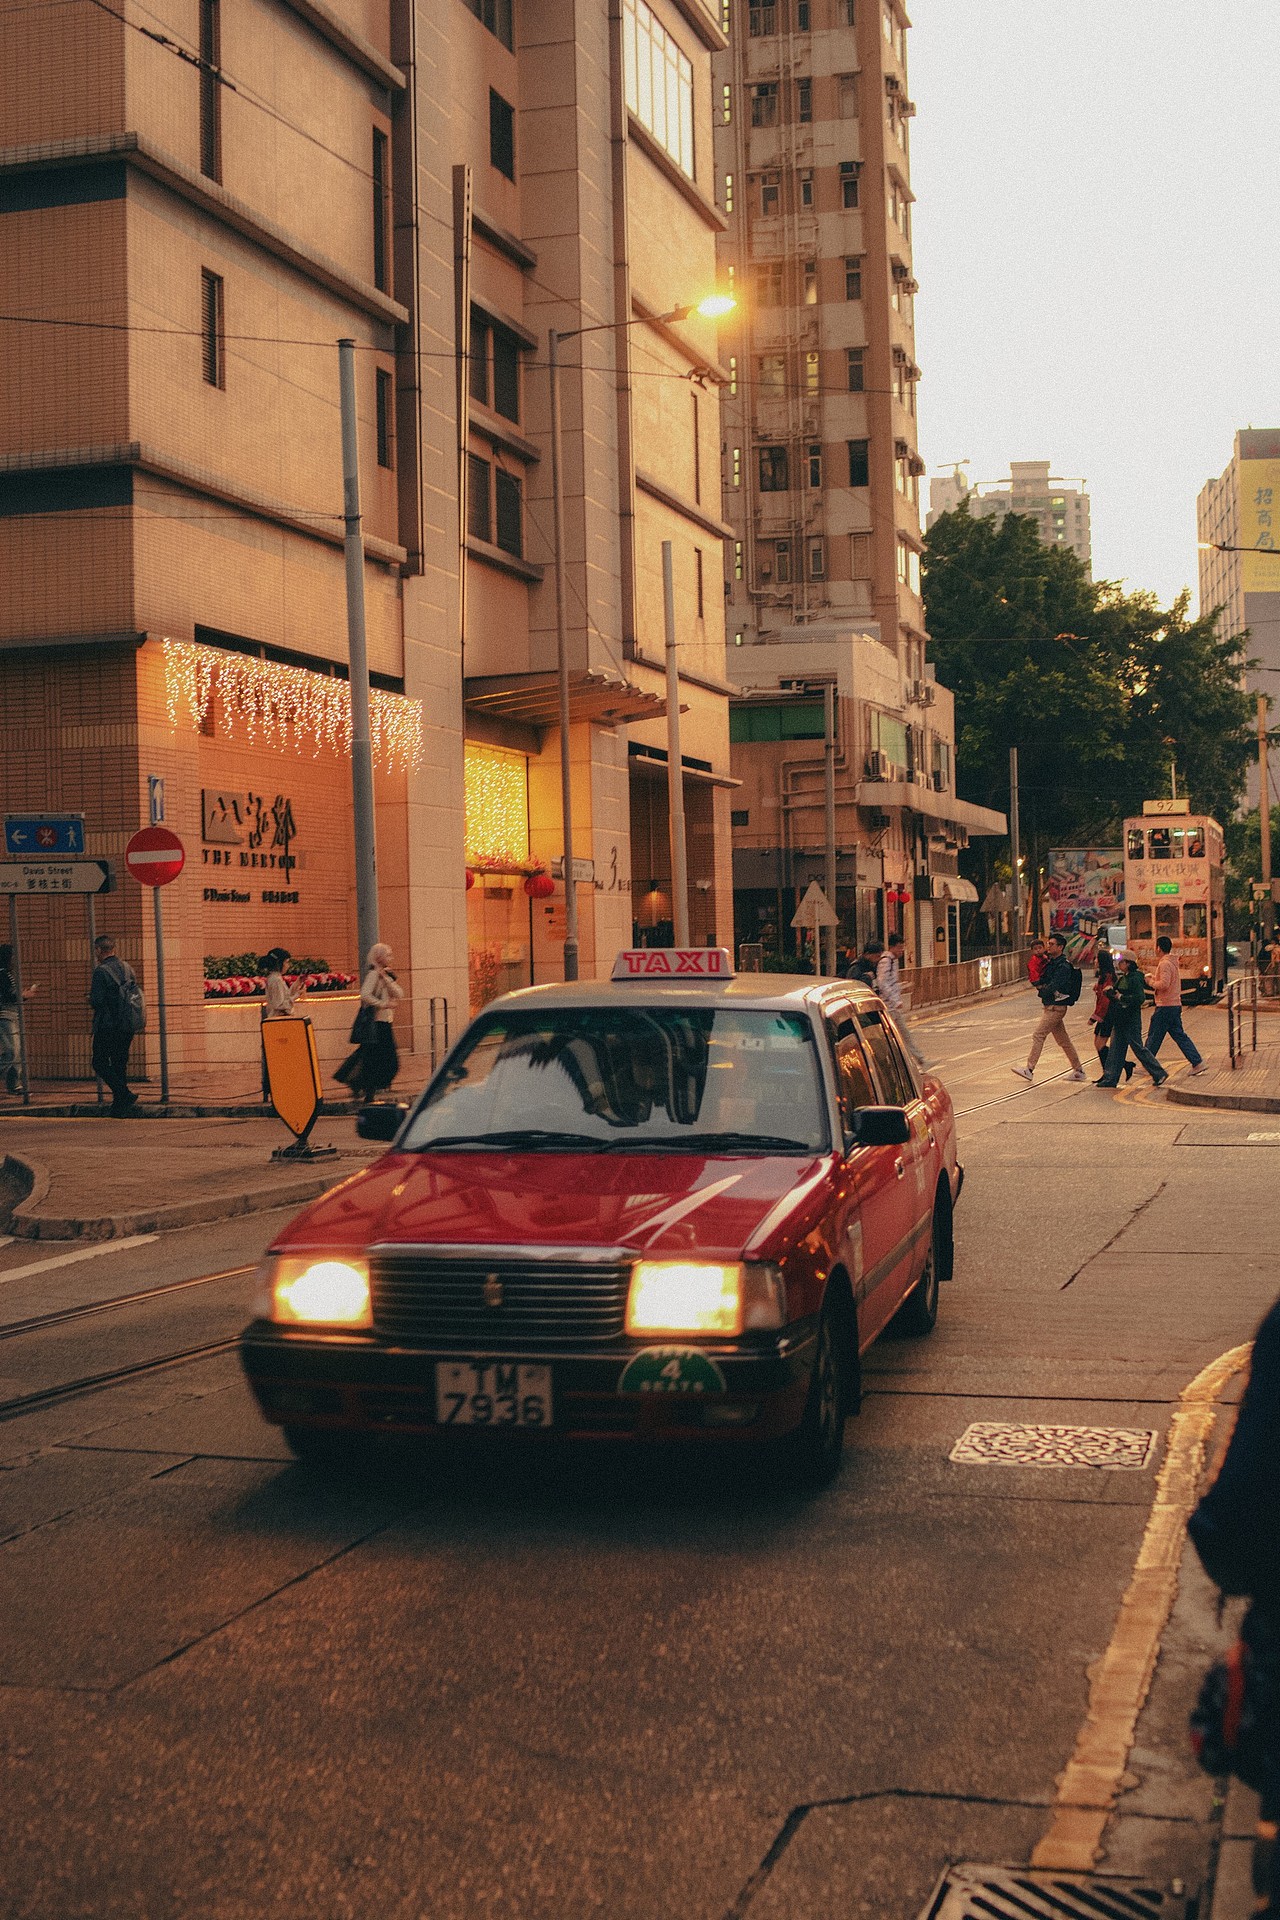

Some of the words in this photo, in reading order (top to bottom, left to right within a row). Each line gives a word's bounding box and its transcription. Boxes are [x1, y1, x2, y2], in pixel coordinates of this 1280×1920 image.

[1254, 486, 1275, 548] 招商局
[1156, 801, 1174, 812] 92
[202, 848, 231, 866] THE
[22, 866, 45, 875] Davis
[47, 866, 73, 875] Street
[622, 951, 721, 974] TAXI
[470, 1360, 518, 1394] TM
[660, 1359, 682, 1380] 4
[443, 1390, 545, 1424] 7936
